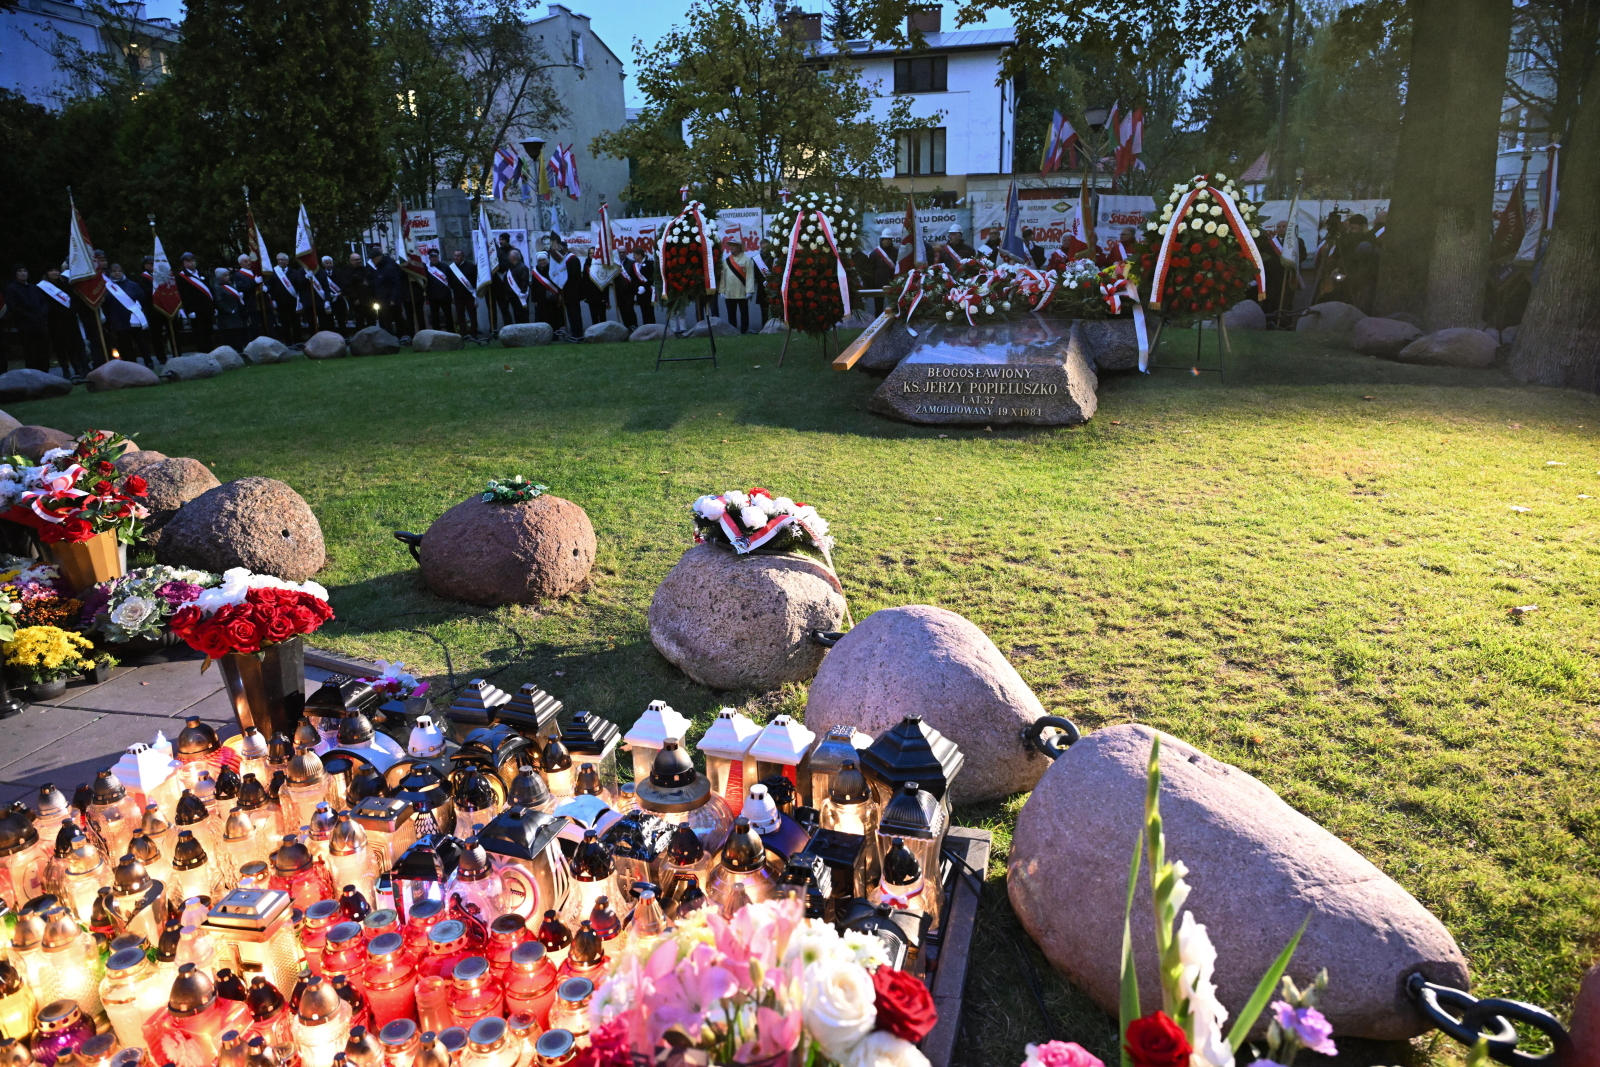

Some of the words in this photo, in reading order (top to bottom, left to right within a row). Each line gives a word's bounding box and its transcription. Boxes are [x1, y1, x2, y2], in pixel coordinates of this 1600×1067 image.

[931, 214, 956, 223] DRÓG
[927, 367, 1033, 379] BŁOGOSŁAWIONY
[903, 381, 921, 393] KS.
[923, 381, 964, 394] JERZY
[969, 382, 1058, 395] POPIEŁUSZKO
[962, 395, 981, 405] LAT
[984, 396, 996, 404] 37
[915, 405, 994, 416] ZAMORDOWANY
[998, 407, 1008, 416] 19
